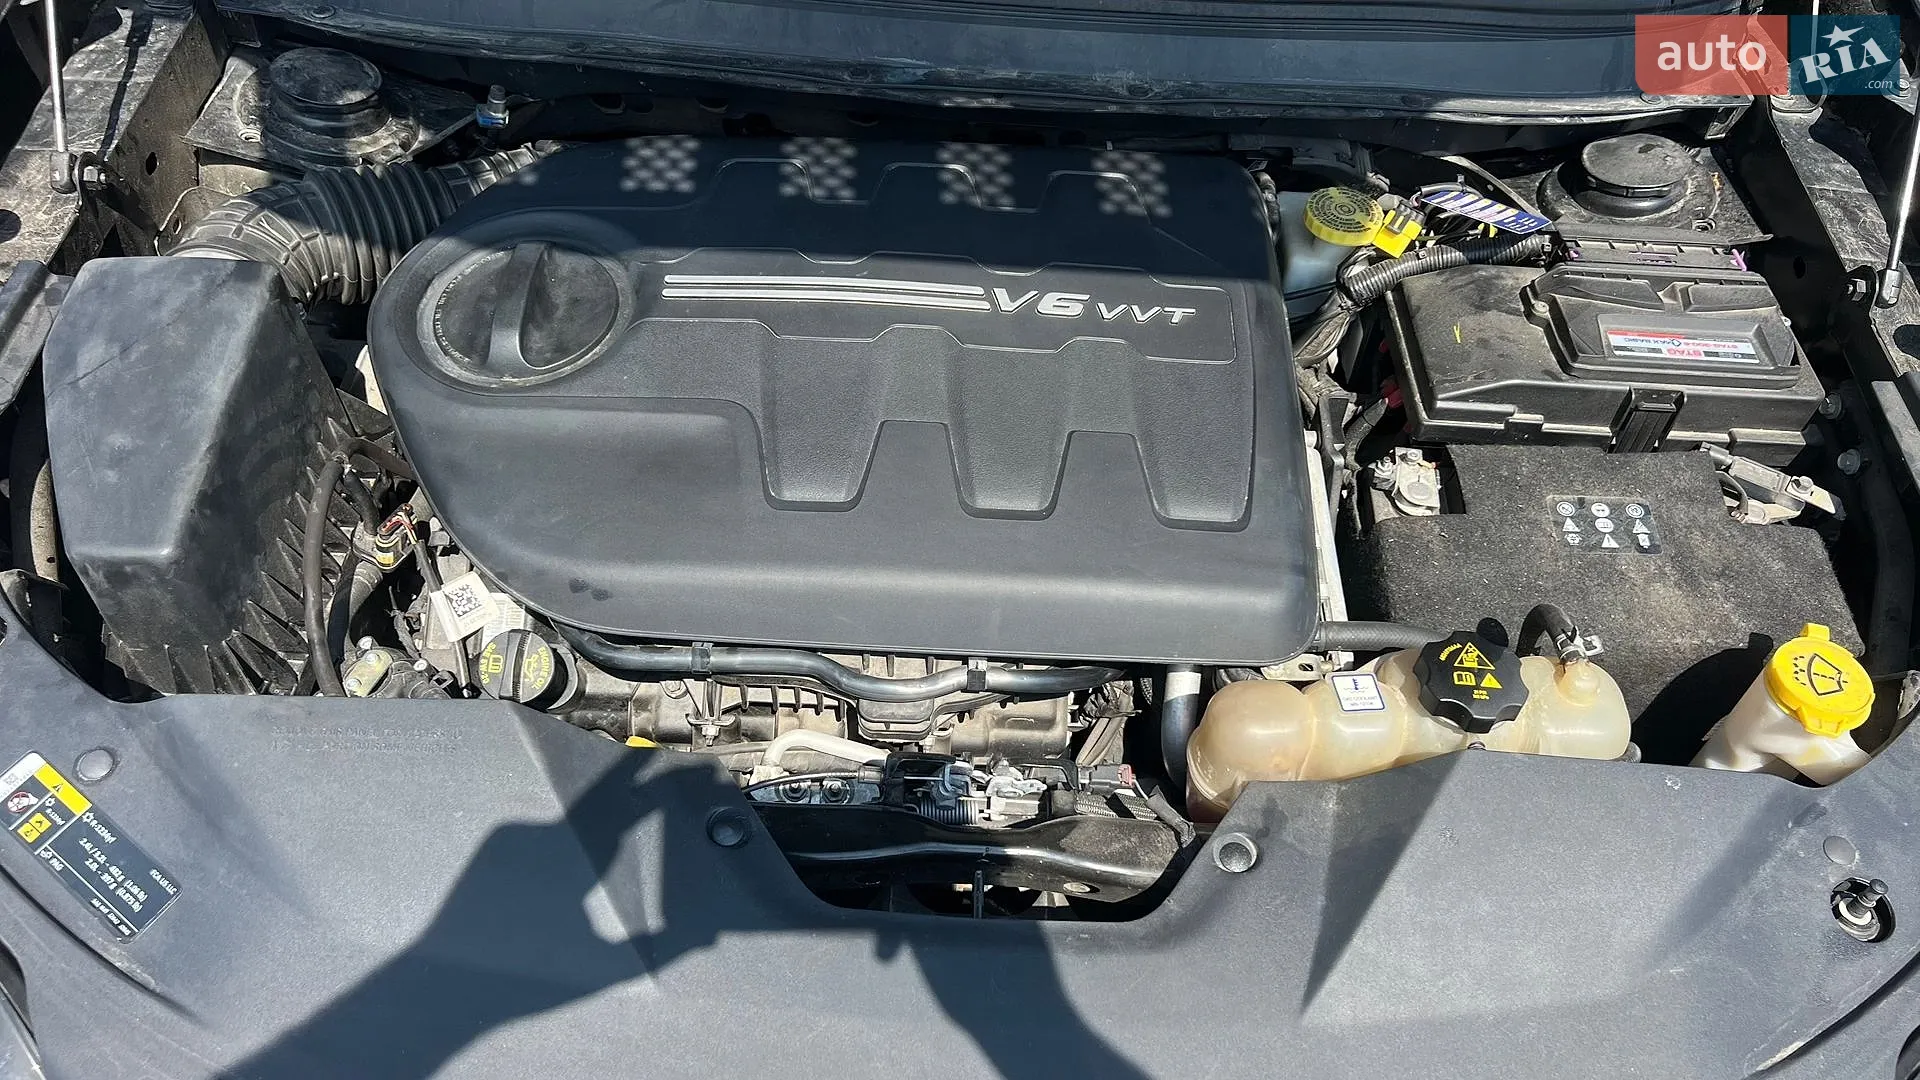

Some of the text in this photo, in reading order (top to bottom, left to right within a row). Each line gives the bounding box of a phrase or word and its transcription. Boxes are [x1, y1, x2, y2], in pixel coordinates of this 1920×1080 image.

[991, 287, 1196, 325] V6 VVT
[531, 646, 550, 690] ENGINE OIL
[90, 819, 118, 844] R-1234yf
[49, 858, 64, 872] PAG
